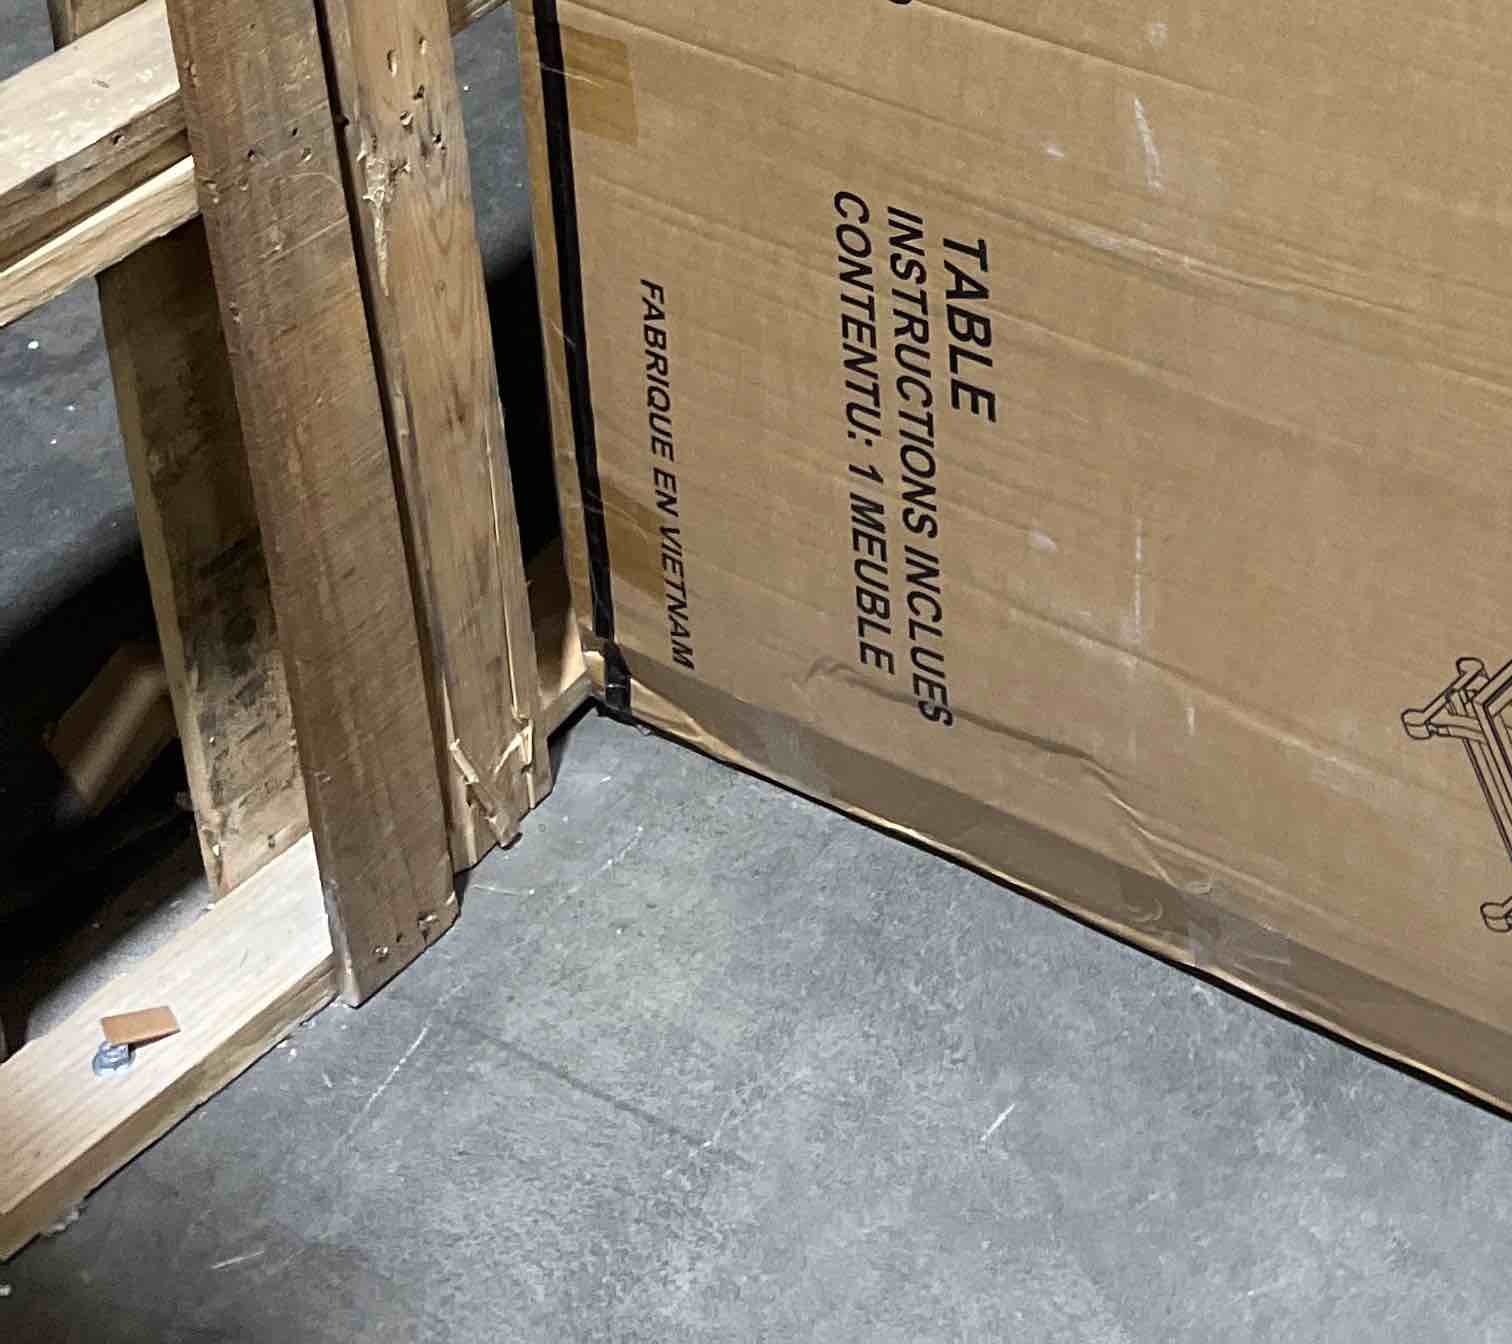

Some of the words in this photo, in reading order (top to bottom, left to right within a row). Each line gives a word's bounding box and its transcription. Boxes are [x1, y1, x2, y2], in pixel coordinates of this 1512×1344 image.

[641, 280, 674, 462] FABRIQUE
[834, 192, 881, 444] CONTENTU:
[888, 207, 937, 538] INSTRUCTIONS
[943, 238, 996, 422] TABLE
[654, 470, 678, 517] EN
[849, 464, 883, 483] 1
[659, 526, 694, 669] VIETNAM
[850, 493, 894, 674] MEUBLE
[904, 545, 952, 726] INCLUES
